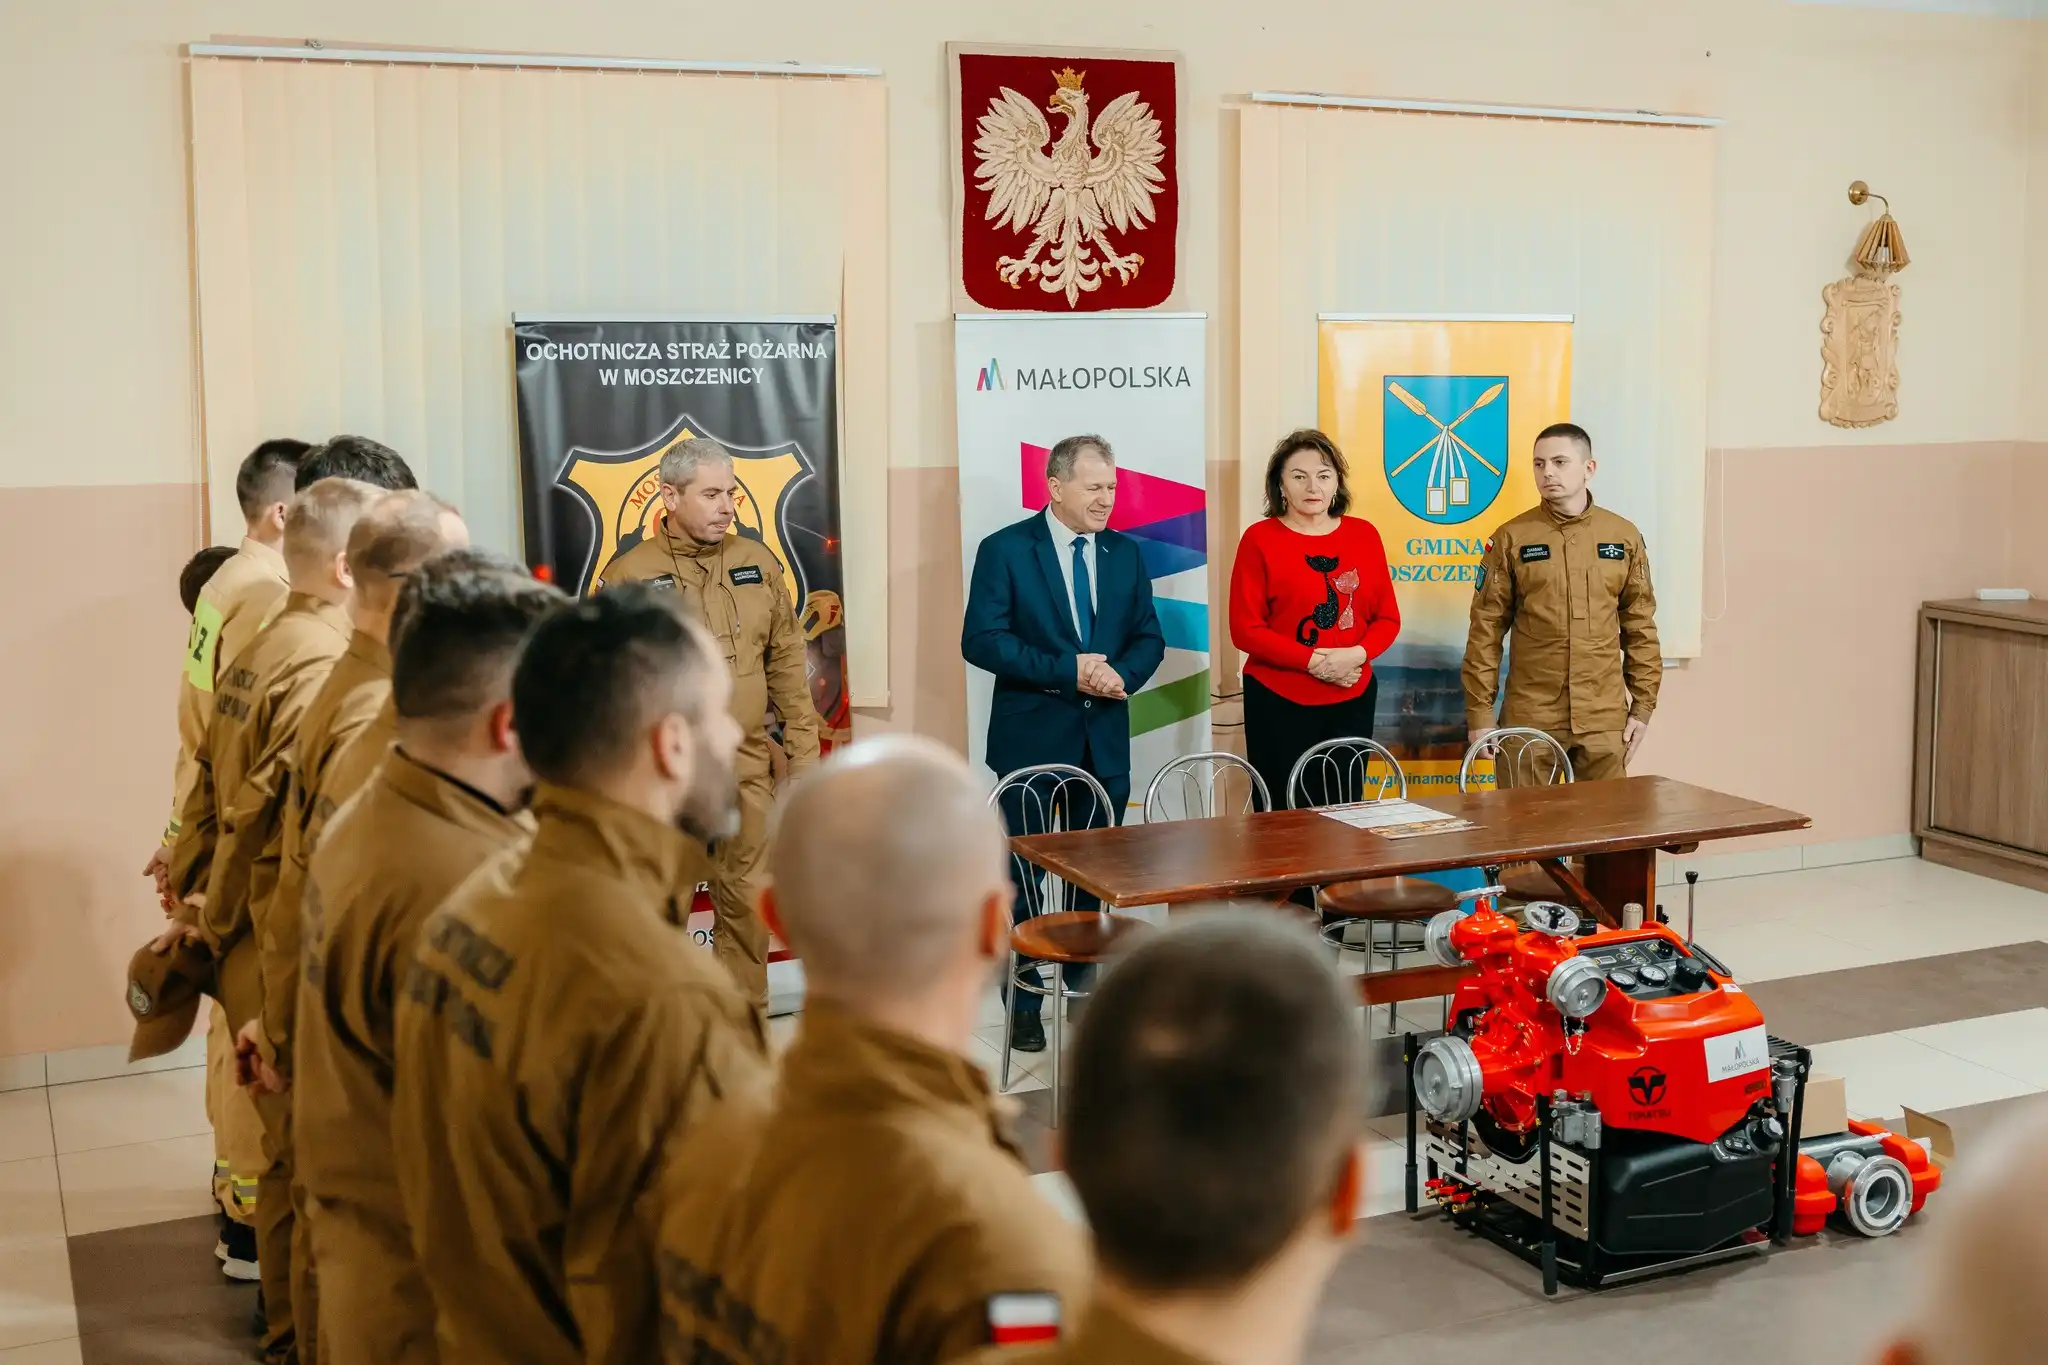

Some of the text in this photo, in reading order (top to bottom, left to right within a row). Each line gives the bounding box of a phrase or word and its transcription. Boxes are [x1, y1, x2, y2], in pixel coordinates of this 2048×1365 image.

[526, 339, 828, 360] OCHOTNICZA STRAŻ POŻARNA
[598, 367, 764, 386] W MOSZCZENICY
[1016, 366, 1191, 390] MAŁOPOLSKA
[1406, 538, 1485, 555] GMINA
